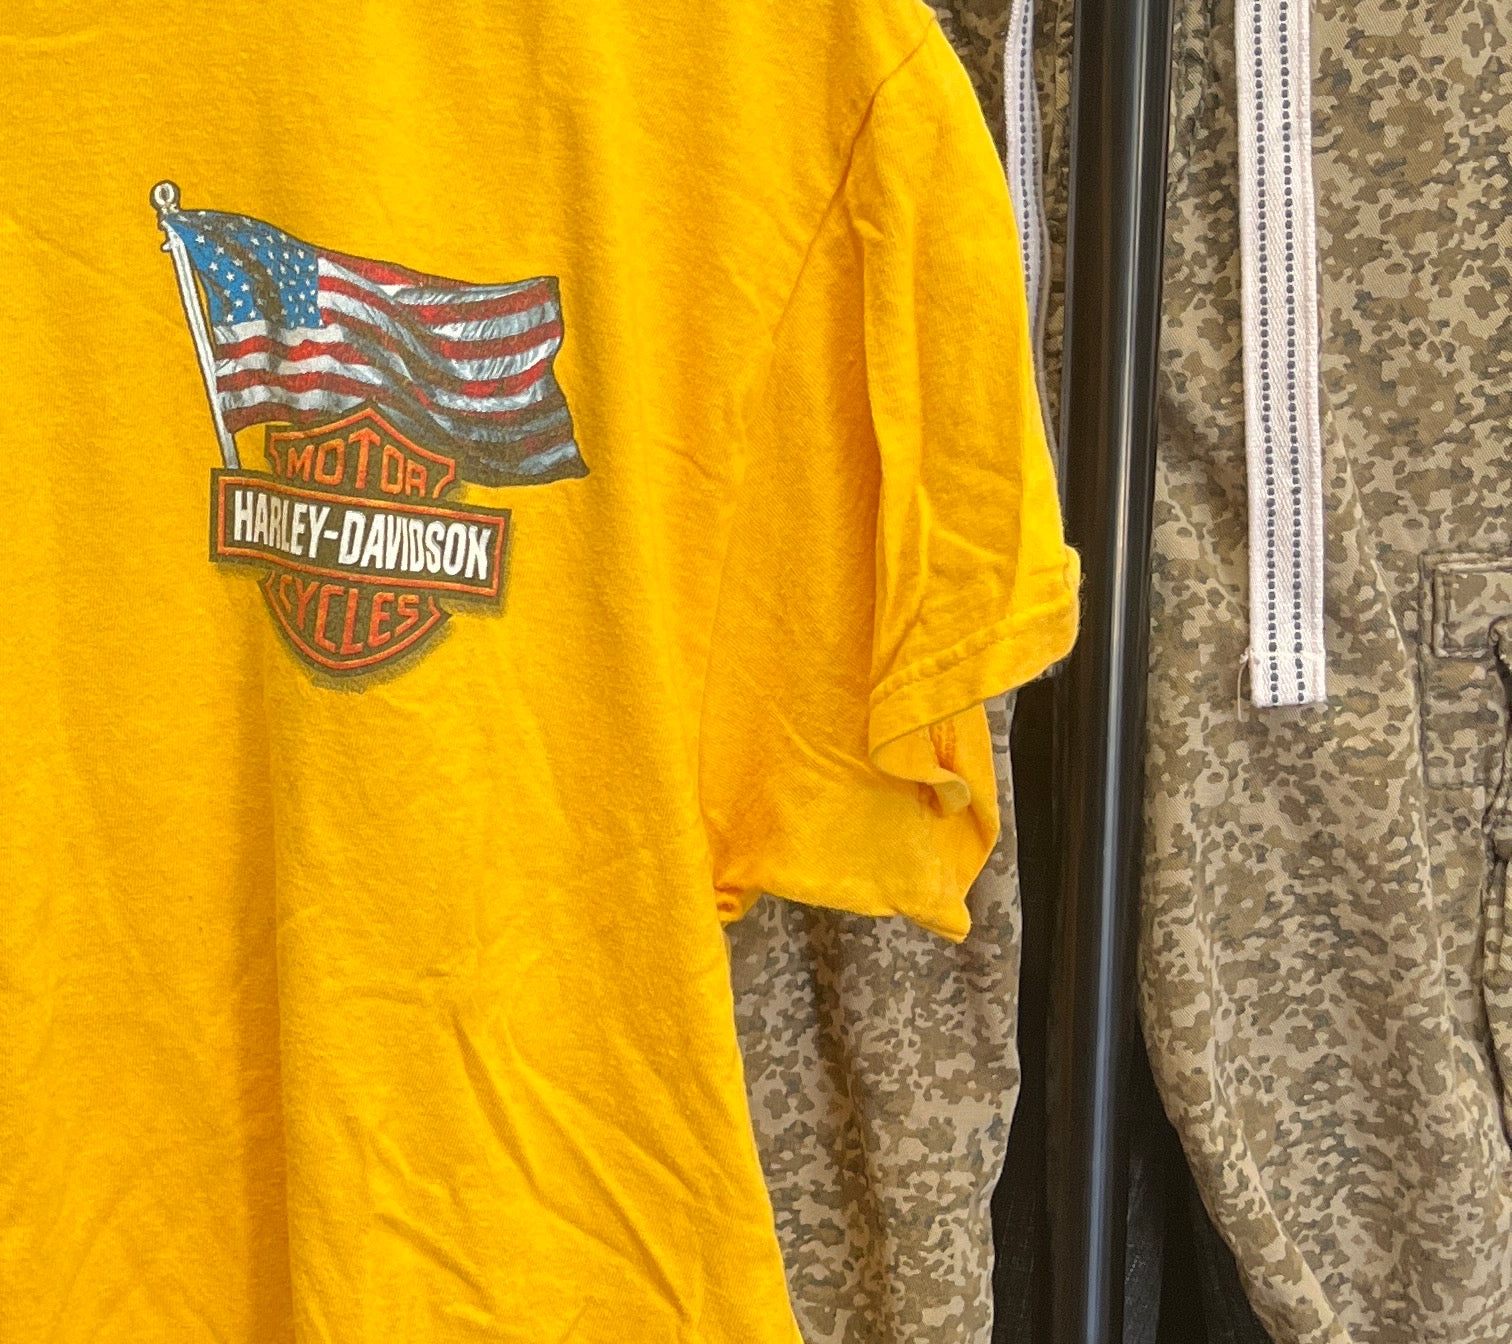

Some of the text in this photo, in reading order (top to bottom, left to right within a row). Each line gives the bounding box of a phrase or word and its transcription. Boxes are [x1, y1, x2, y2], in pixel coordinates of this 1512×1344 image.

[287, 427, 427, 498] MOTOR
[233, 489, 492, 580] HARLEY-DAVIDSON
[279, 575, 420, 655] CYCLES
